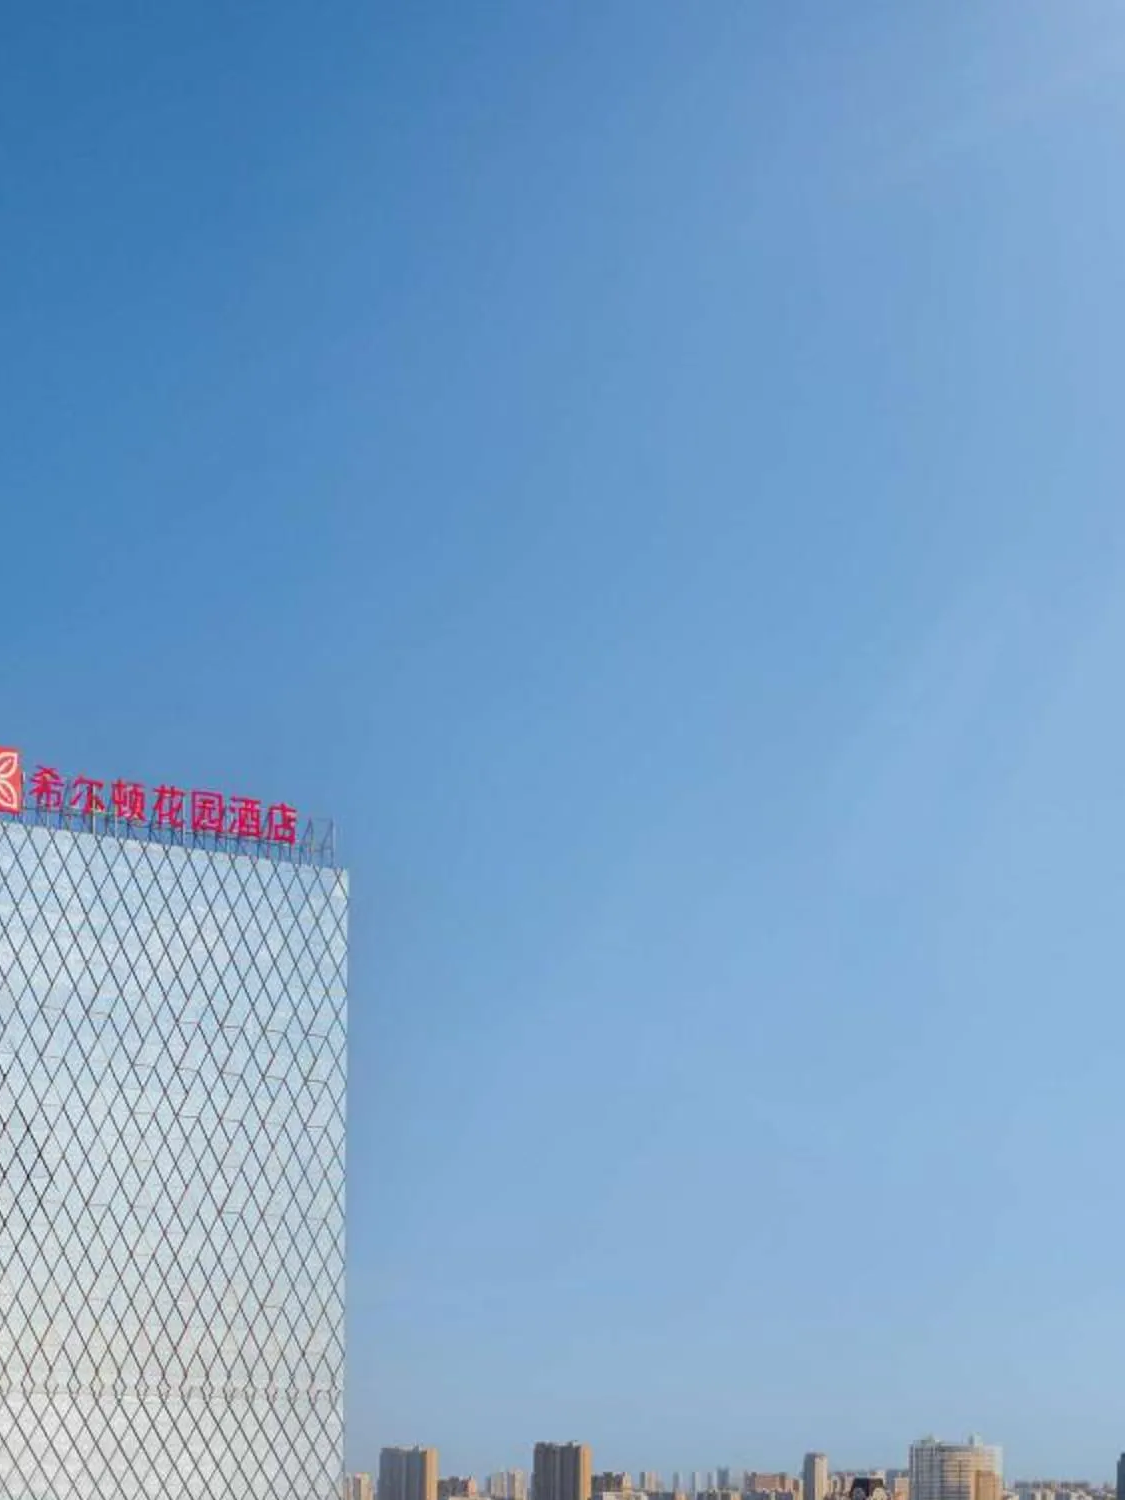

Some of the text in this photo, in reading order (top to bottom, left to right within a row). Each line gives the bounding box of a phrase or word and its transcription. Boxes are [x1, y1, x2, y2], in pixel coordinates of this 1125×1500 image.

[30, 766, 297, 845] 希尔顿花园酒店
